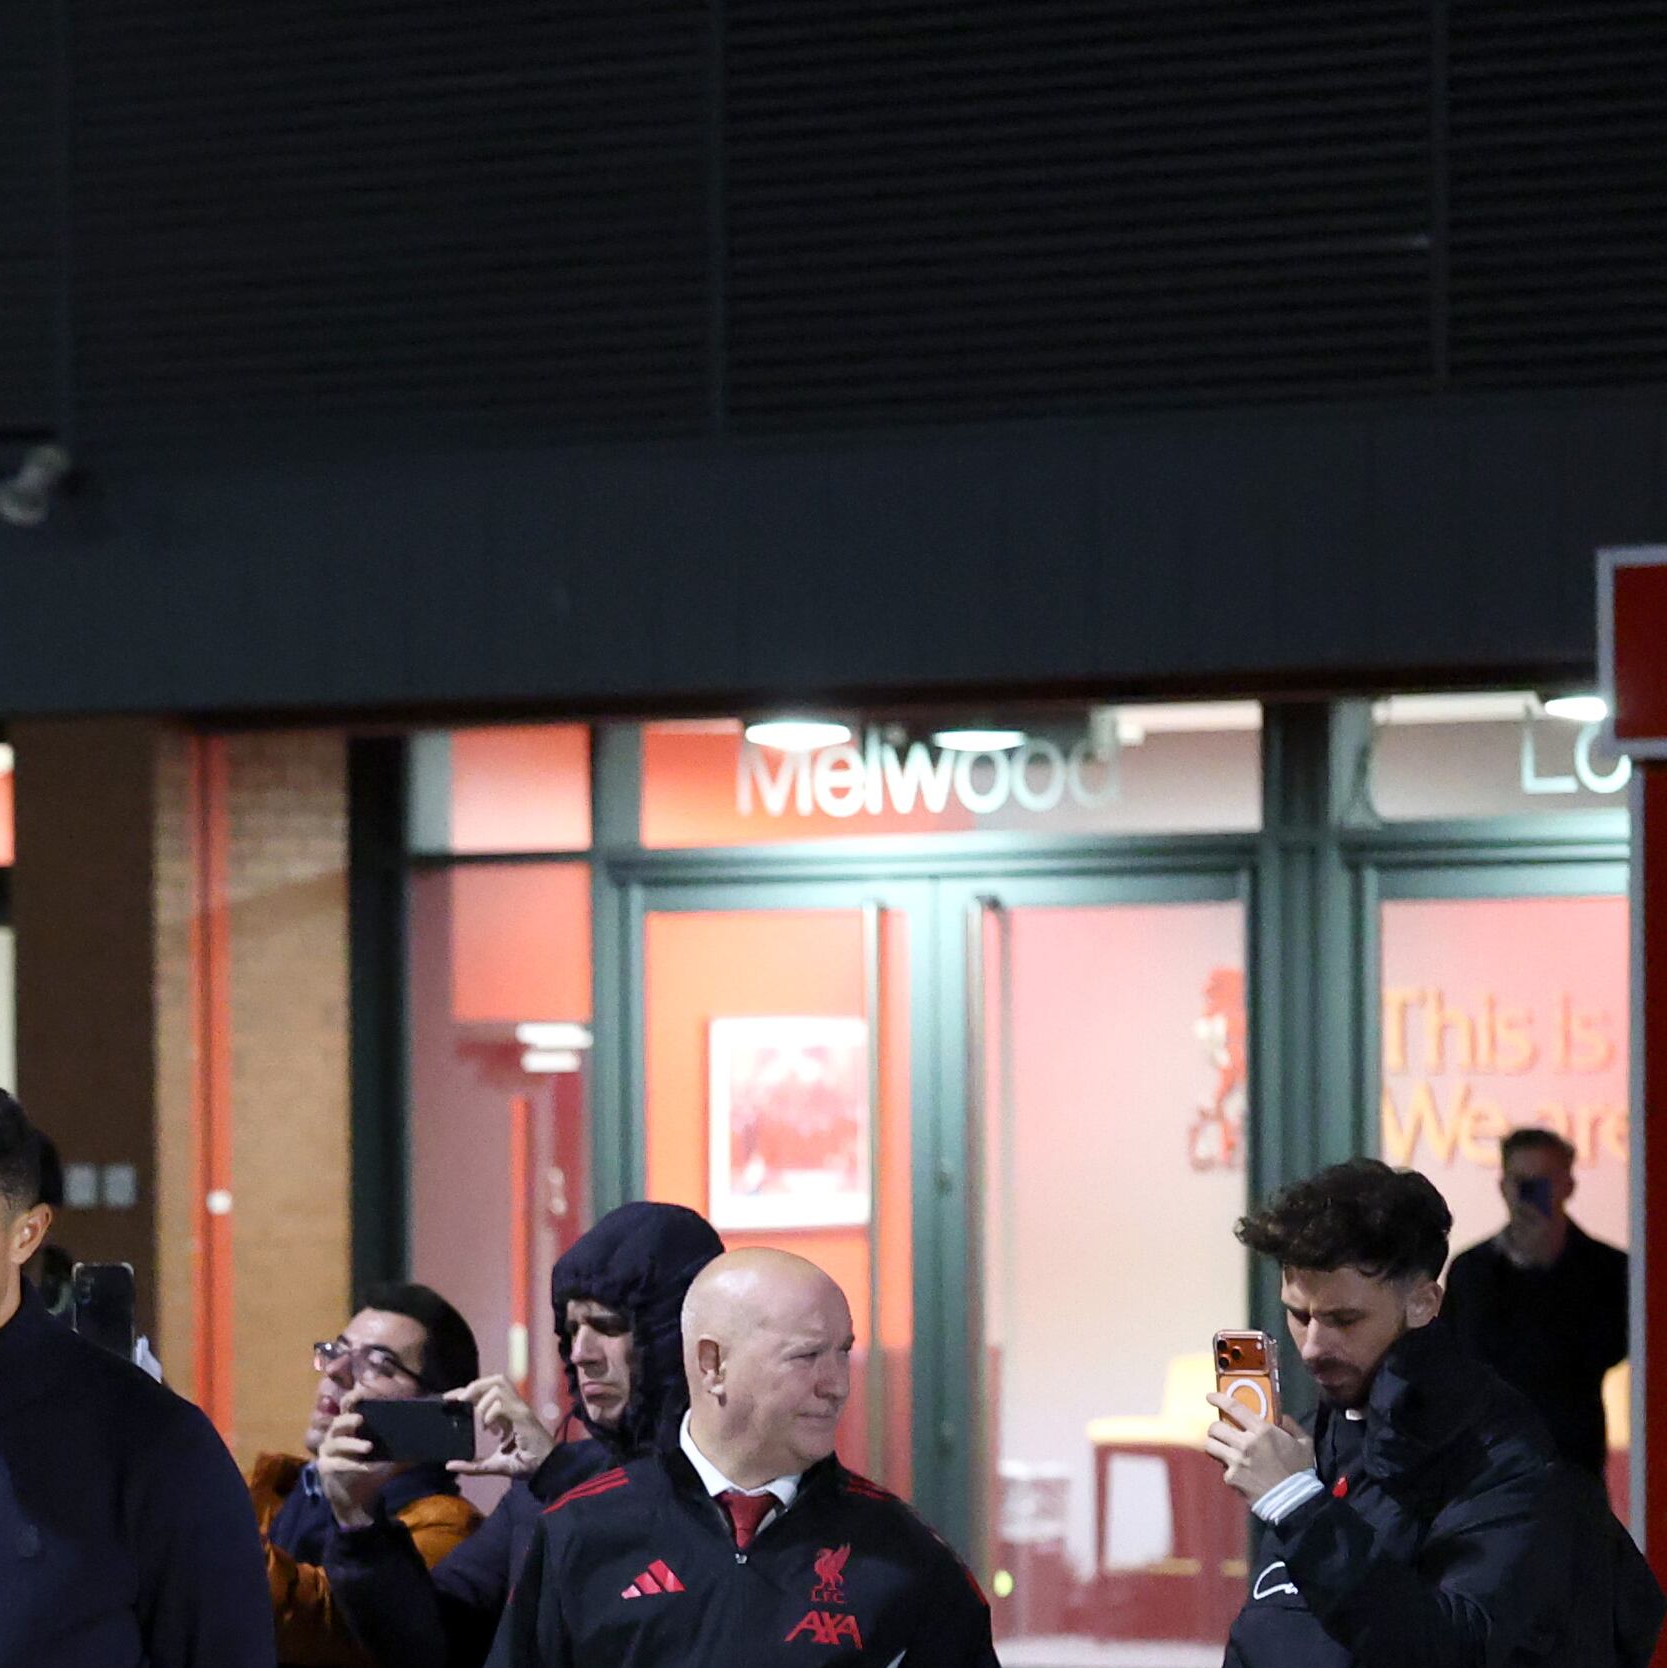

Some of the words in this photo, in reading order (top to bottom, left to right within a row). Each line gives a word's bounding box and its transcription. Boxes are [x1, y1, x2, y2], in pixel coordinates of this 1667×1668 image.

[736, 722, 1119, 818] Melwood
[1383, 988, 1540, 1076] This
[1553, 990, 1617, 1076] is
[1382, 1081, 1509, 1168] We
[784, 1609, 863, 1651] AXA
